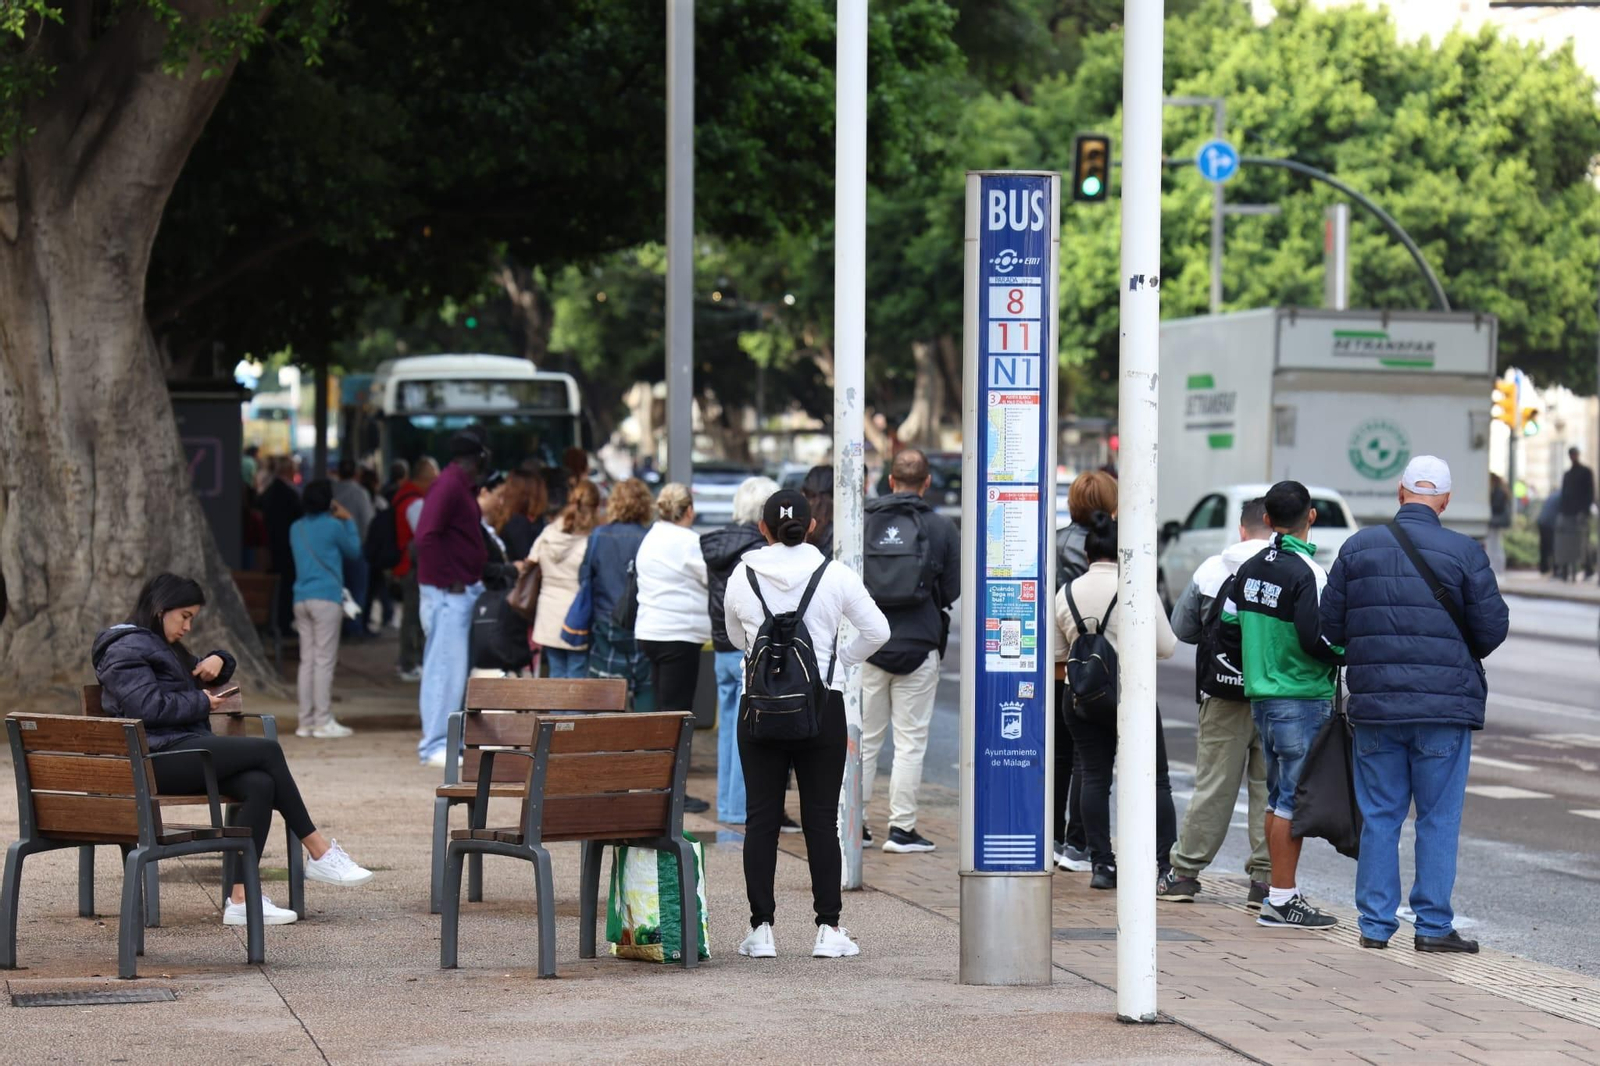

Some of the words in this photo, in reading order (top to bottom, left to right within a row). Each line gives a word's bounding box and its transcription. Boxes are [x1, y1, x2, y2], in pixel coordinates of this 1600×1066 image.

[988, 189, 1044, 231] BUS
[1007, 288, 1024, 315] 8
[998, 322, 1029, 351] 11
[994, 357, 1031, 386] N1
[990, 394, 996, 404] 3
[989, 490, 995, 500] 8
[984, 748, 1037, 757] Ayuntamiento
[991, 758, 1001, 767] de
[1003, 758, 1031, 768] Málaga
